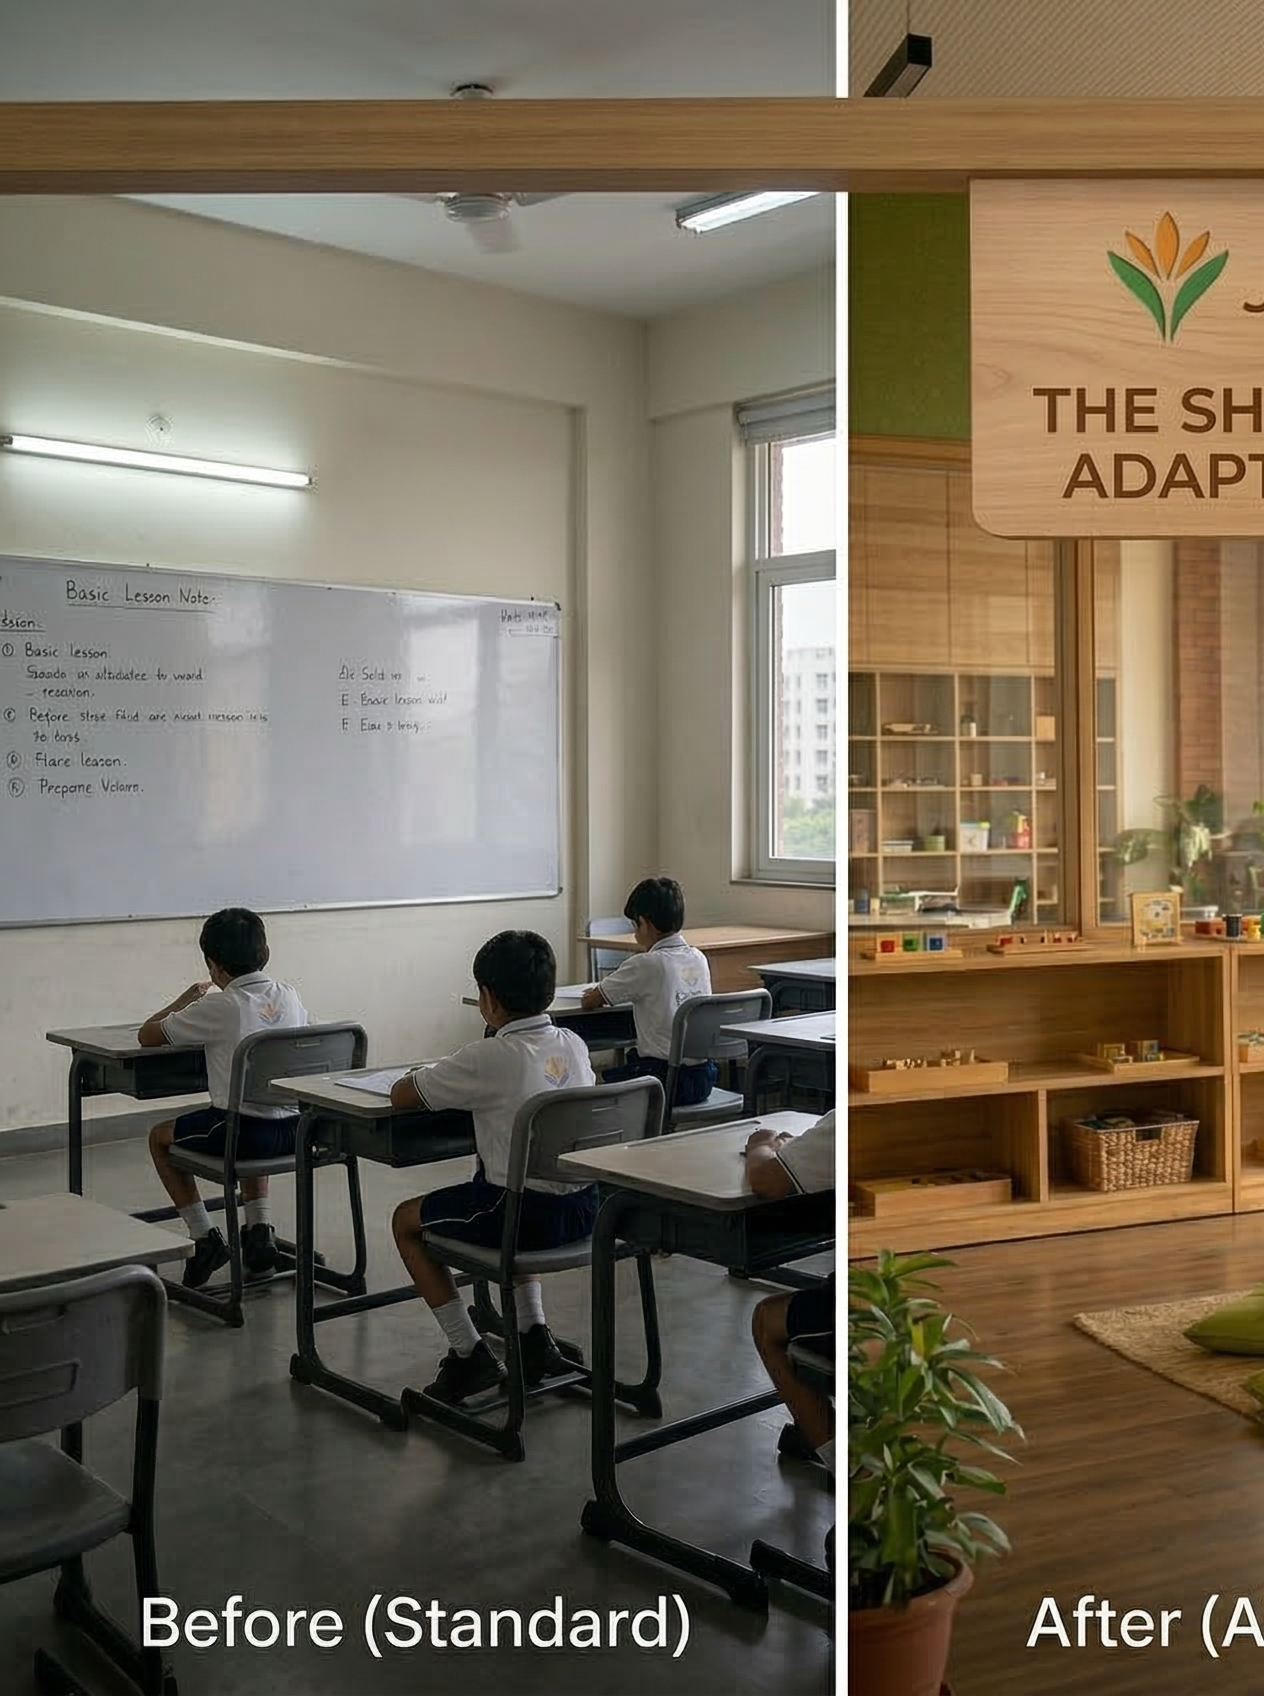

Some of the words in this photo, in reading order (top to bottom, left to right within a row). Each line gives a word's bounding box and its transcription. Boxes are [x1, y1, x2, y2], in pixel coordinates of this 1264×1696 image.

[1032, 387, 1160, 434] THE
[66, 579, 110, 601] Basic
[25, 641, 60, 658] Basic
